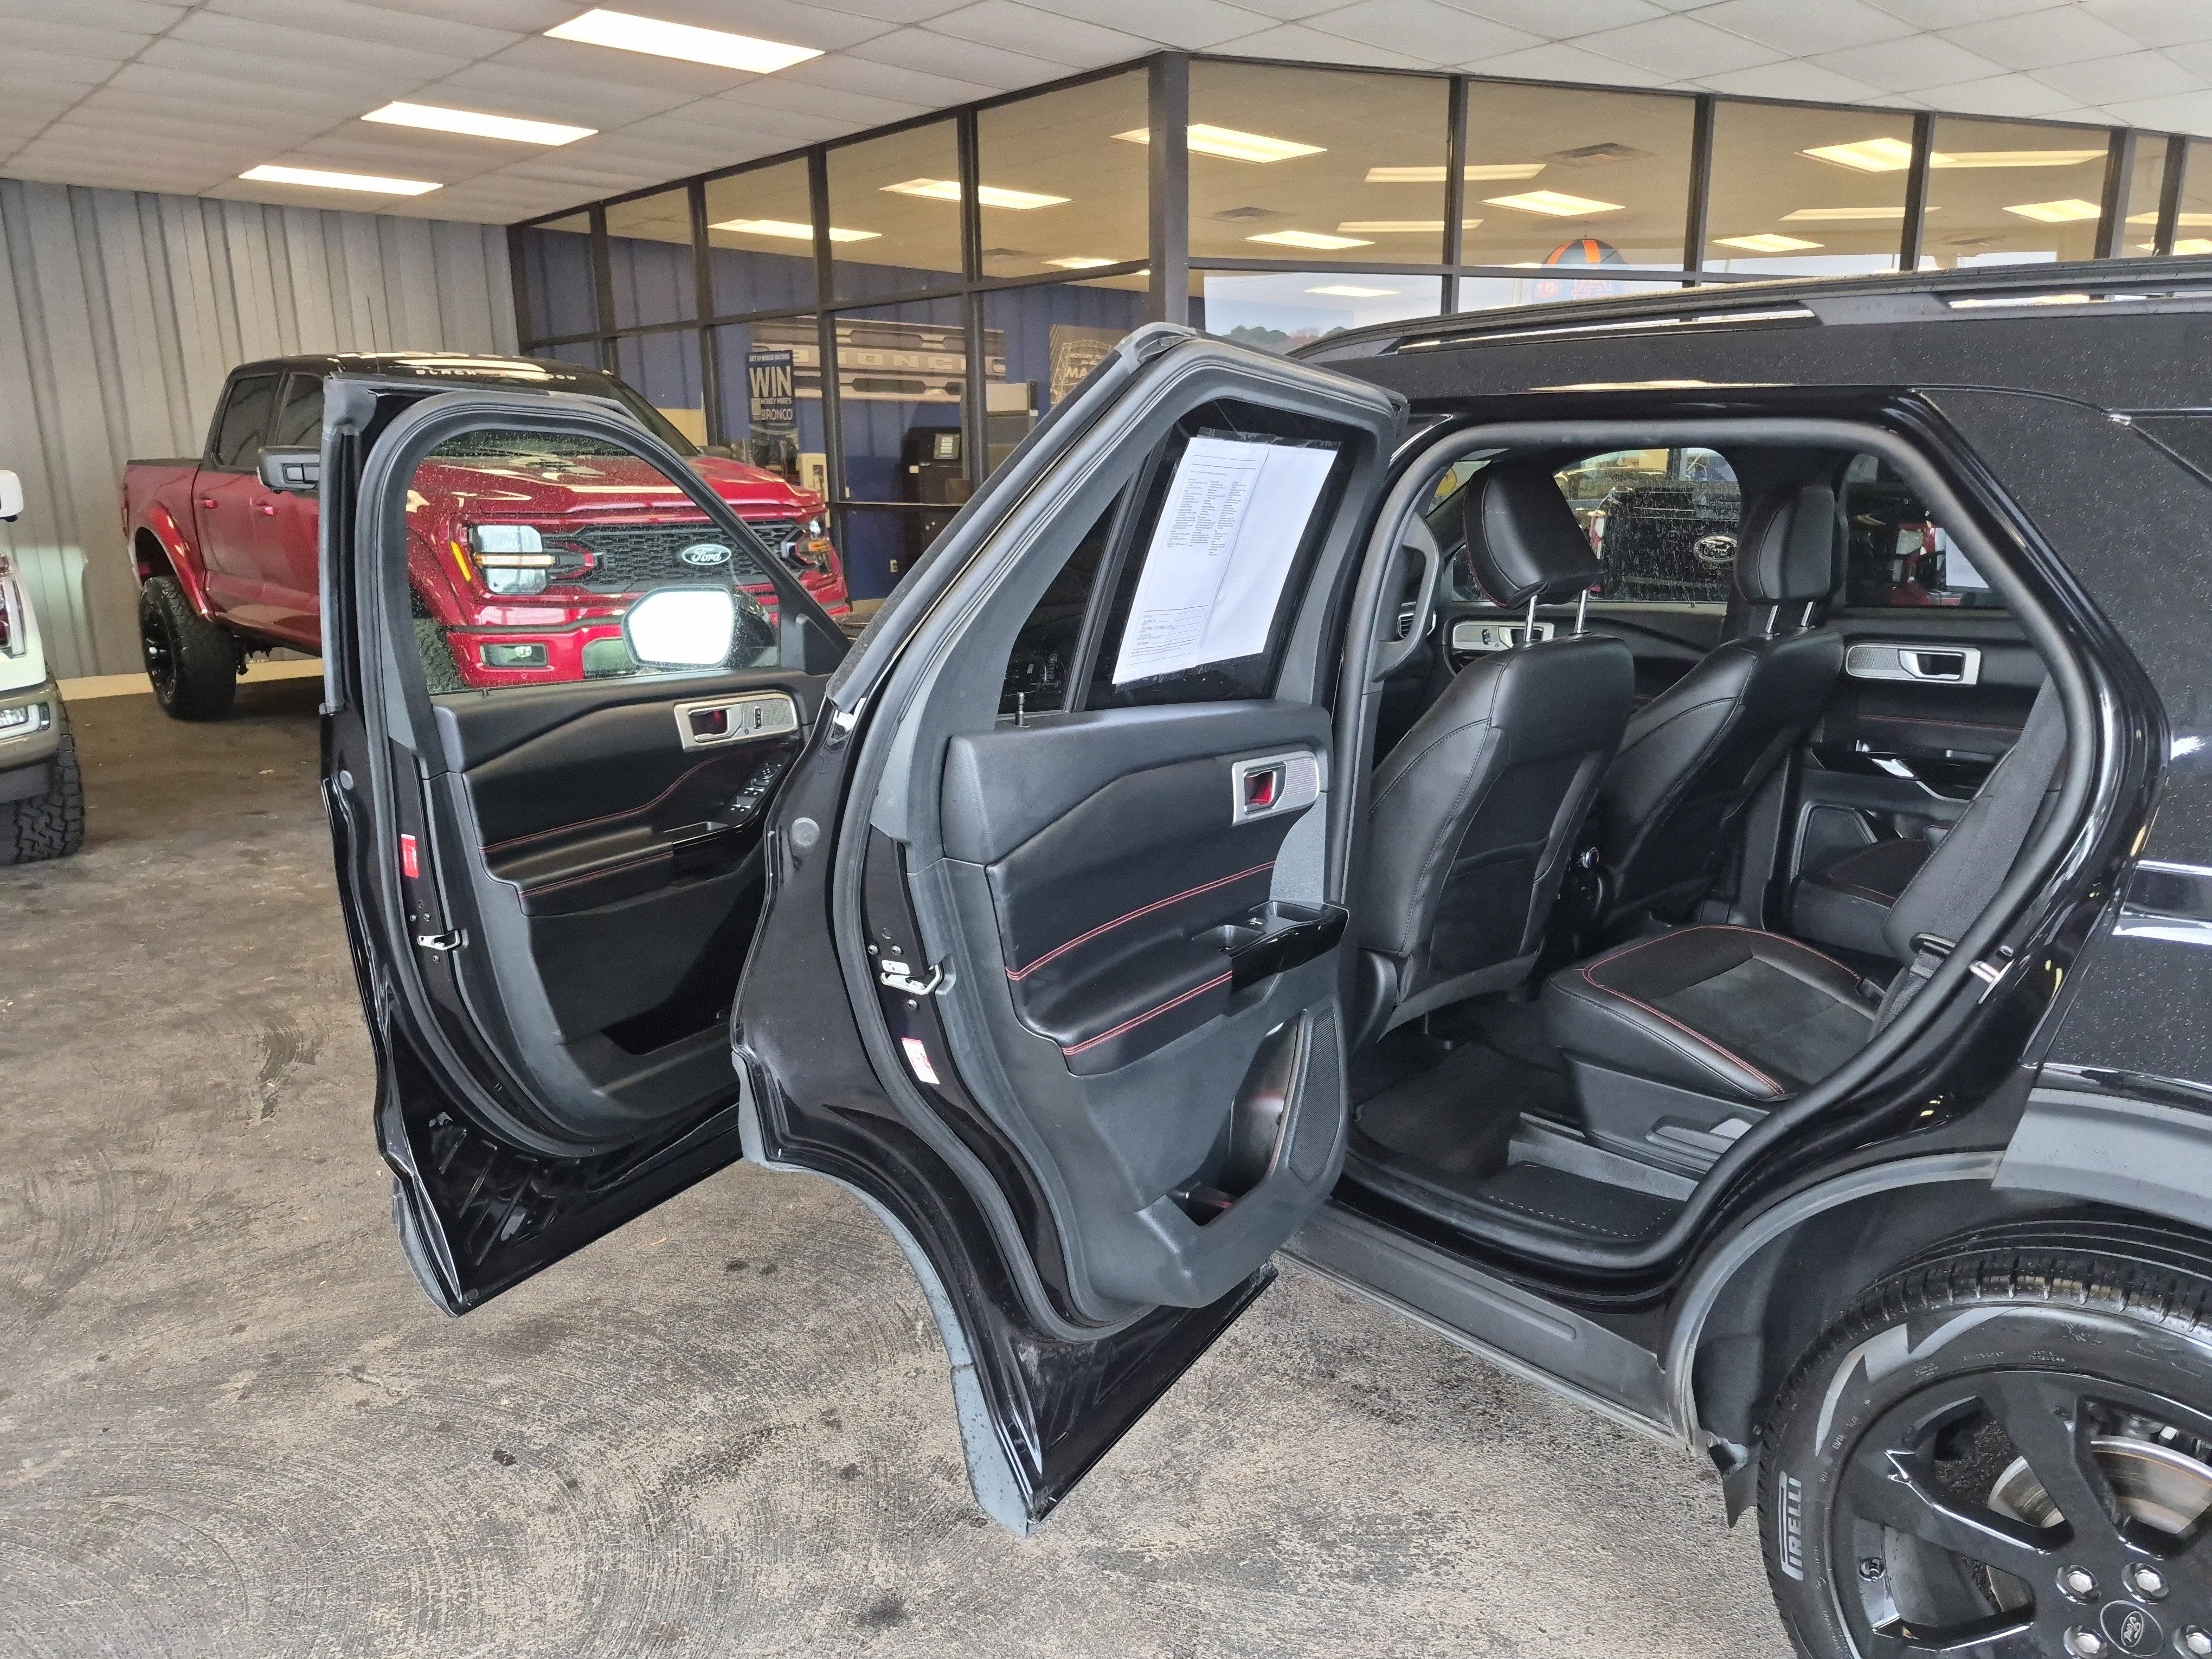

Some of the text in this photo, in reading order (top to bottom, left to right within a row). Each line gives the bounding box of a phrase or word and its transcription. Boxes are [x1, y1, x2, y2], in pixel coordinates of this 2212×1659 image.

[749, 365, 792, 397] WIN
[761, 408, 793, 421] BRONCO
[692, 547, 722, 562] Ford
[1778, 1471, 1804, 1581] PIRELLI
[2123, 1616, 2142, 1643] Ford
